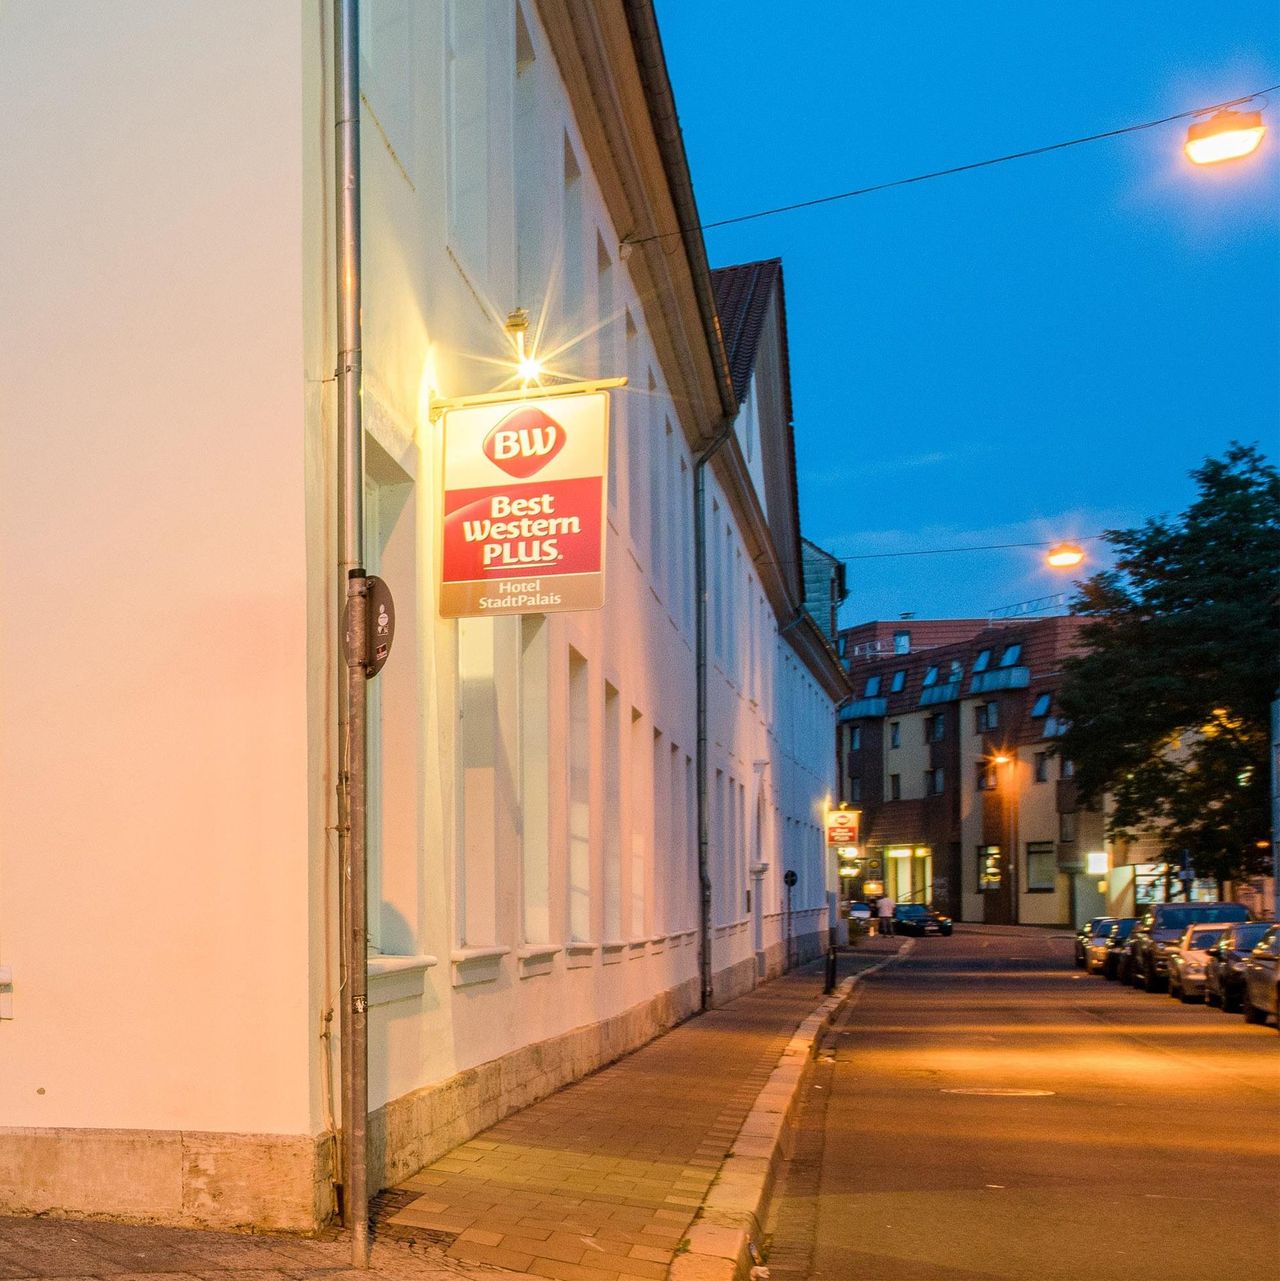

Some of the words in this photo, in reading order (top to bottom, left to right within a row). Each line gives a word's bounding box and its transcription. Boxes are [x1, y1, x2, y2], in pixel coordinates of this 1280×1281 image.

[494, 425, 557, 460] BW
[491, 493, 555, 519] Best
[462, 516, 581, 542] Western
[498, 580, 540, 594] Hotel
[478, 593, 562, 609] StadtPalais
